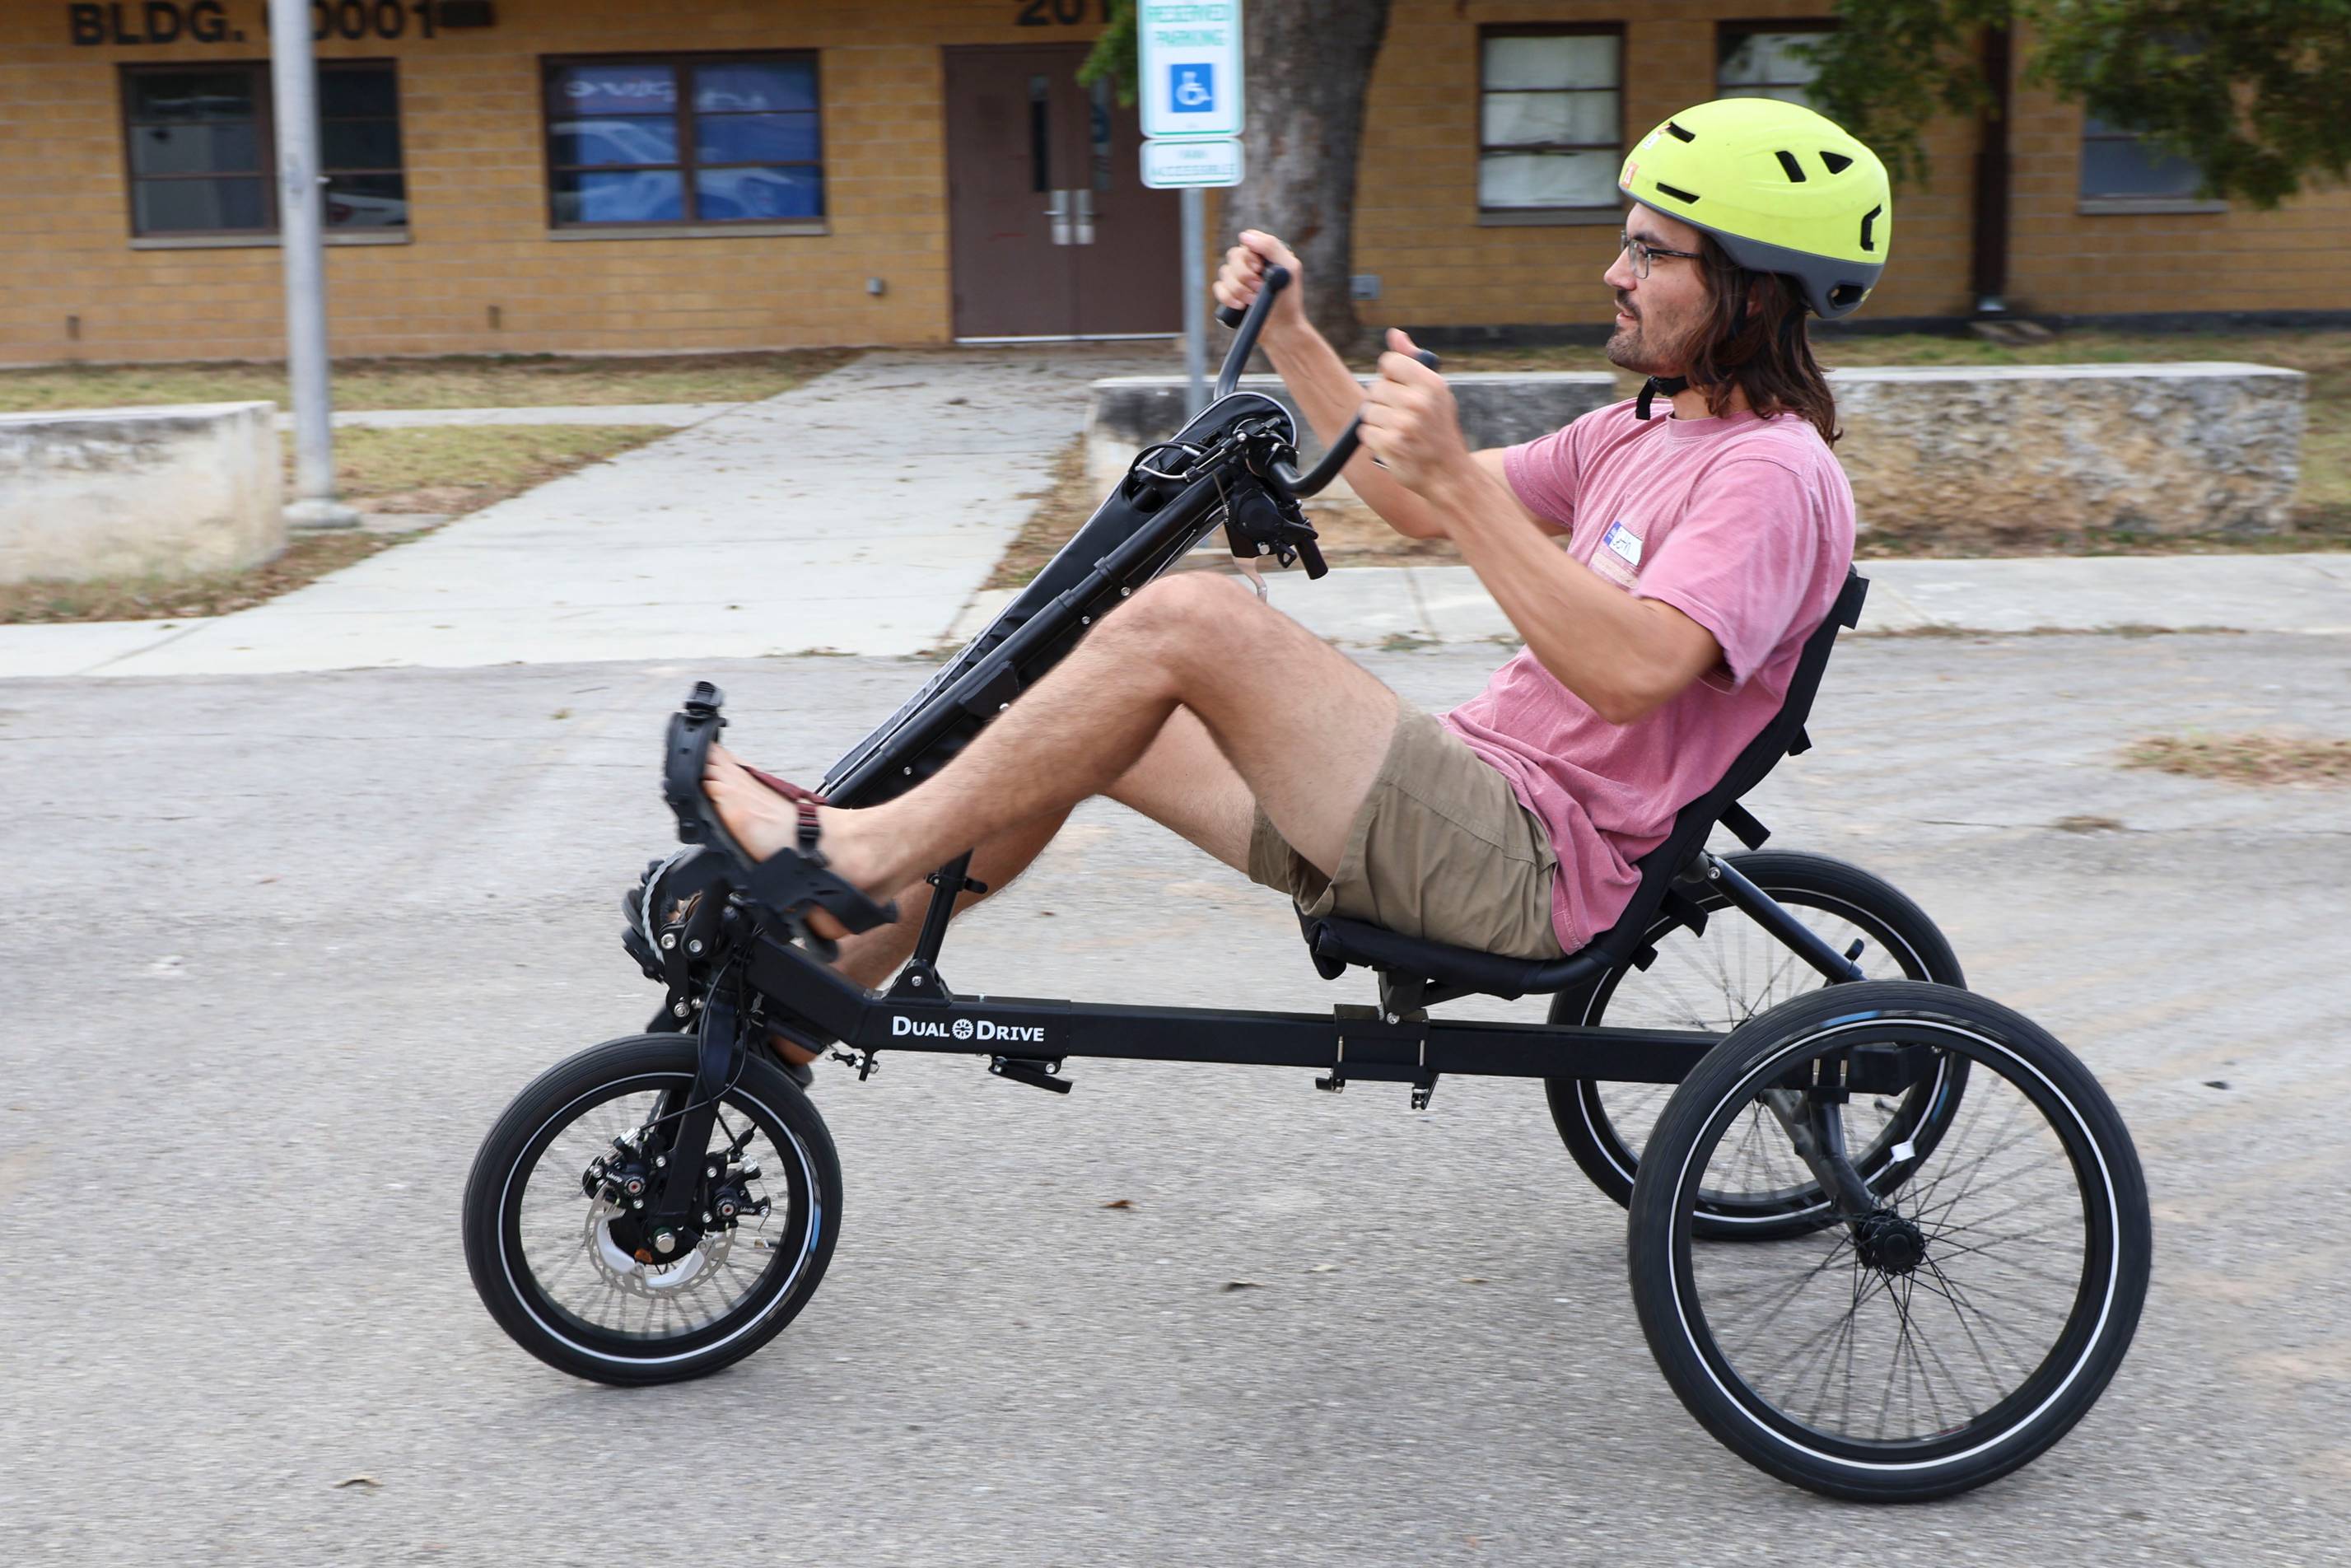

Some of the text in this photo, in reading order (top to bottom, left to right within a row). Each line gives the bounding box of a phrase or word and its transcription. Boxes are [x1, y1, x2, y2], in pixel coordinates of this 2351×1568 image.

[71, 0, 434, 44] BLDG. 0001
[893, 1015, 1044, 1042] DUAL DRIVE
